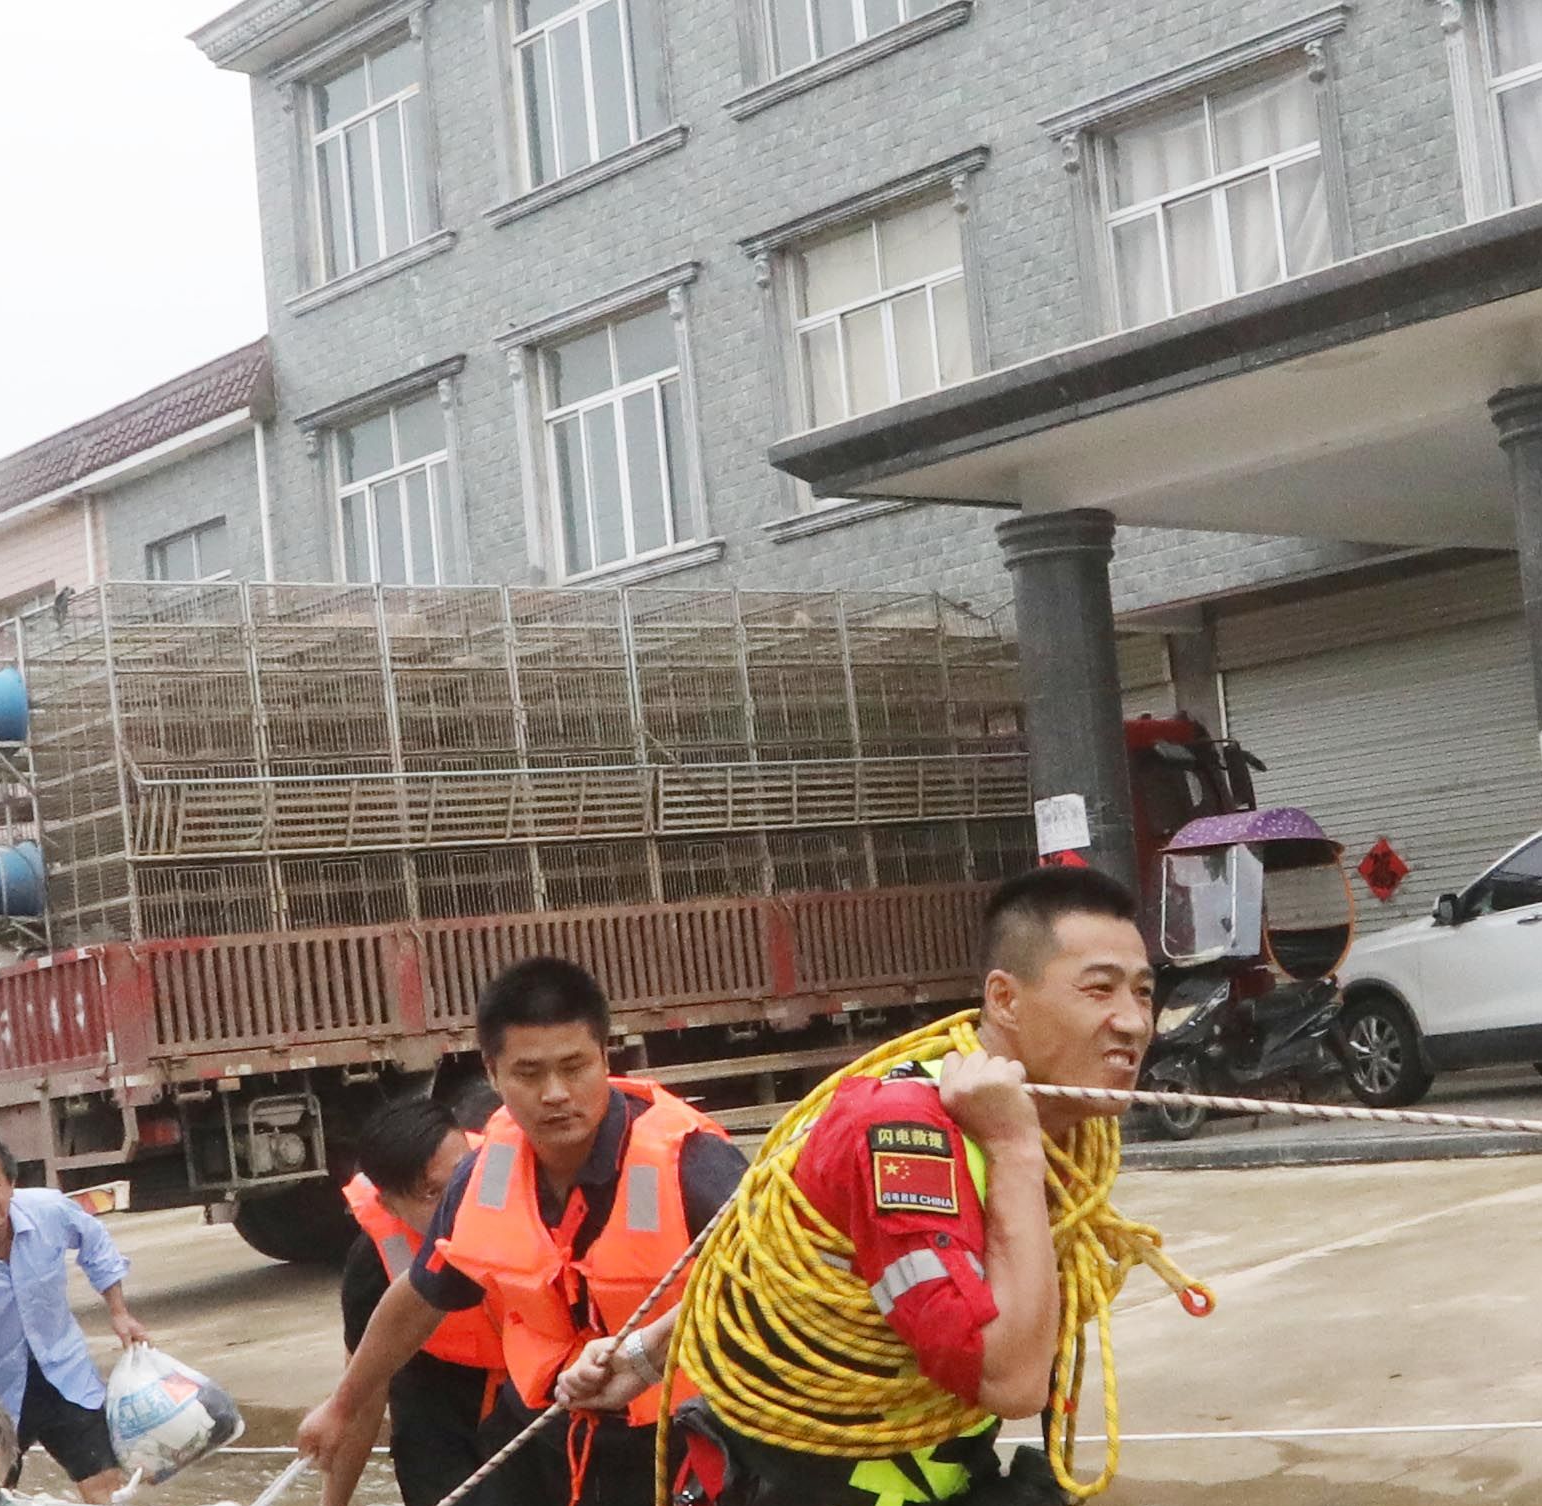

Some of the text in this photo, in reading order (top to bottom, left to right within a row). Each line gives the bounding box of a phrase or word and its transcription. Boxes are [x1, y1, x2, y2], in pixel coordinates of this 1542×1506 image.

[878, 1128, 943, 1149] 闪电救援
[919, 1195, 953, 1207] CHINA
